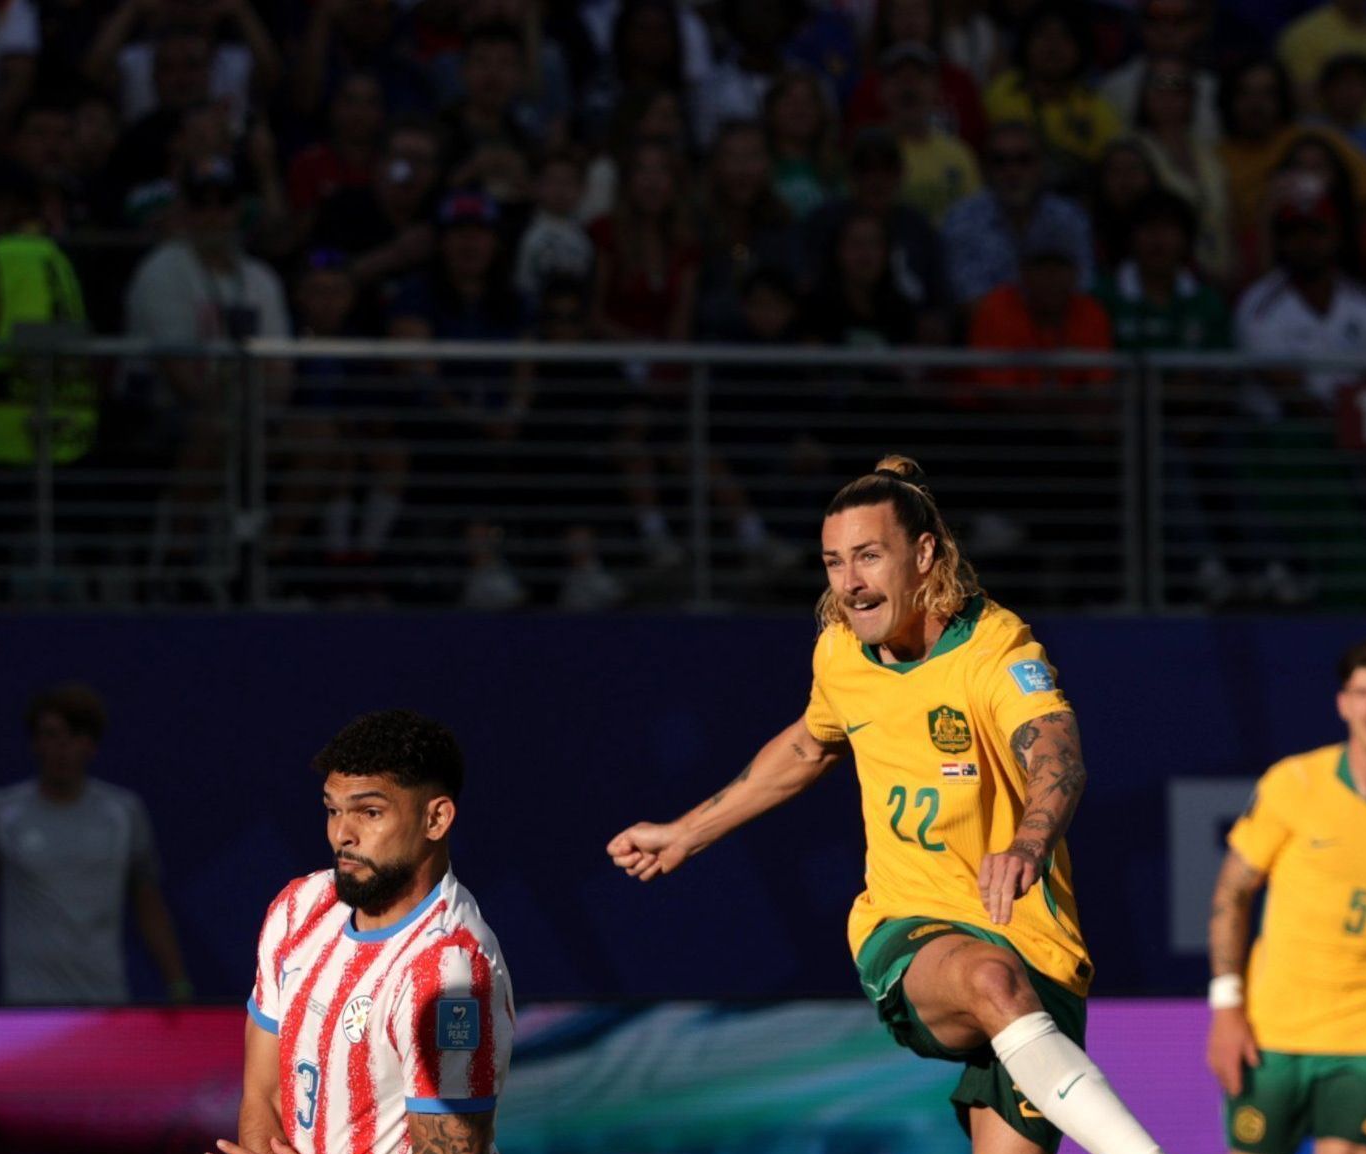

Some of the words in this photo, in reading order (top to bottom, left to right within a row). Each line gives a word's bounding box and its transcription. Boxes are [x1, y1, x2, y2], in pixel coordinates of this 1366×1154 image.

[886, 784, 947, 853] 22
[447, 1030, 470, 1040] PEACE
[294, 1058, 320, 1131] 3
